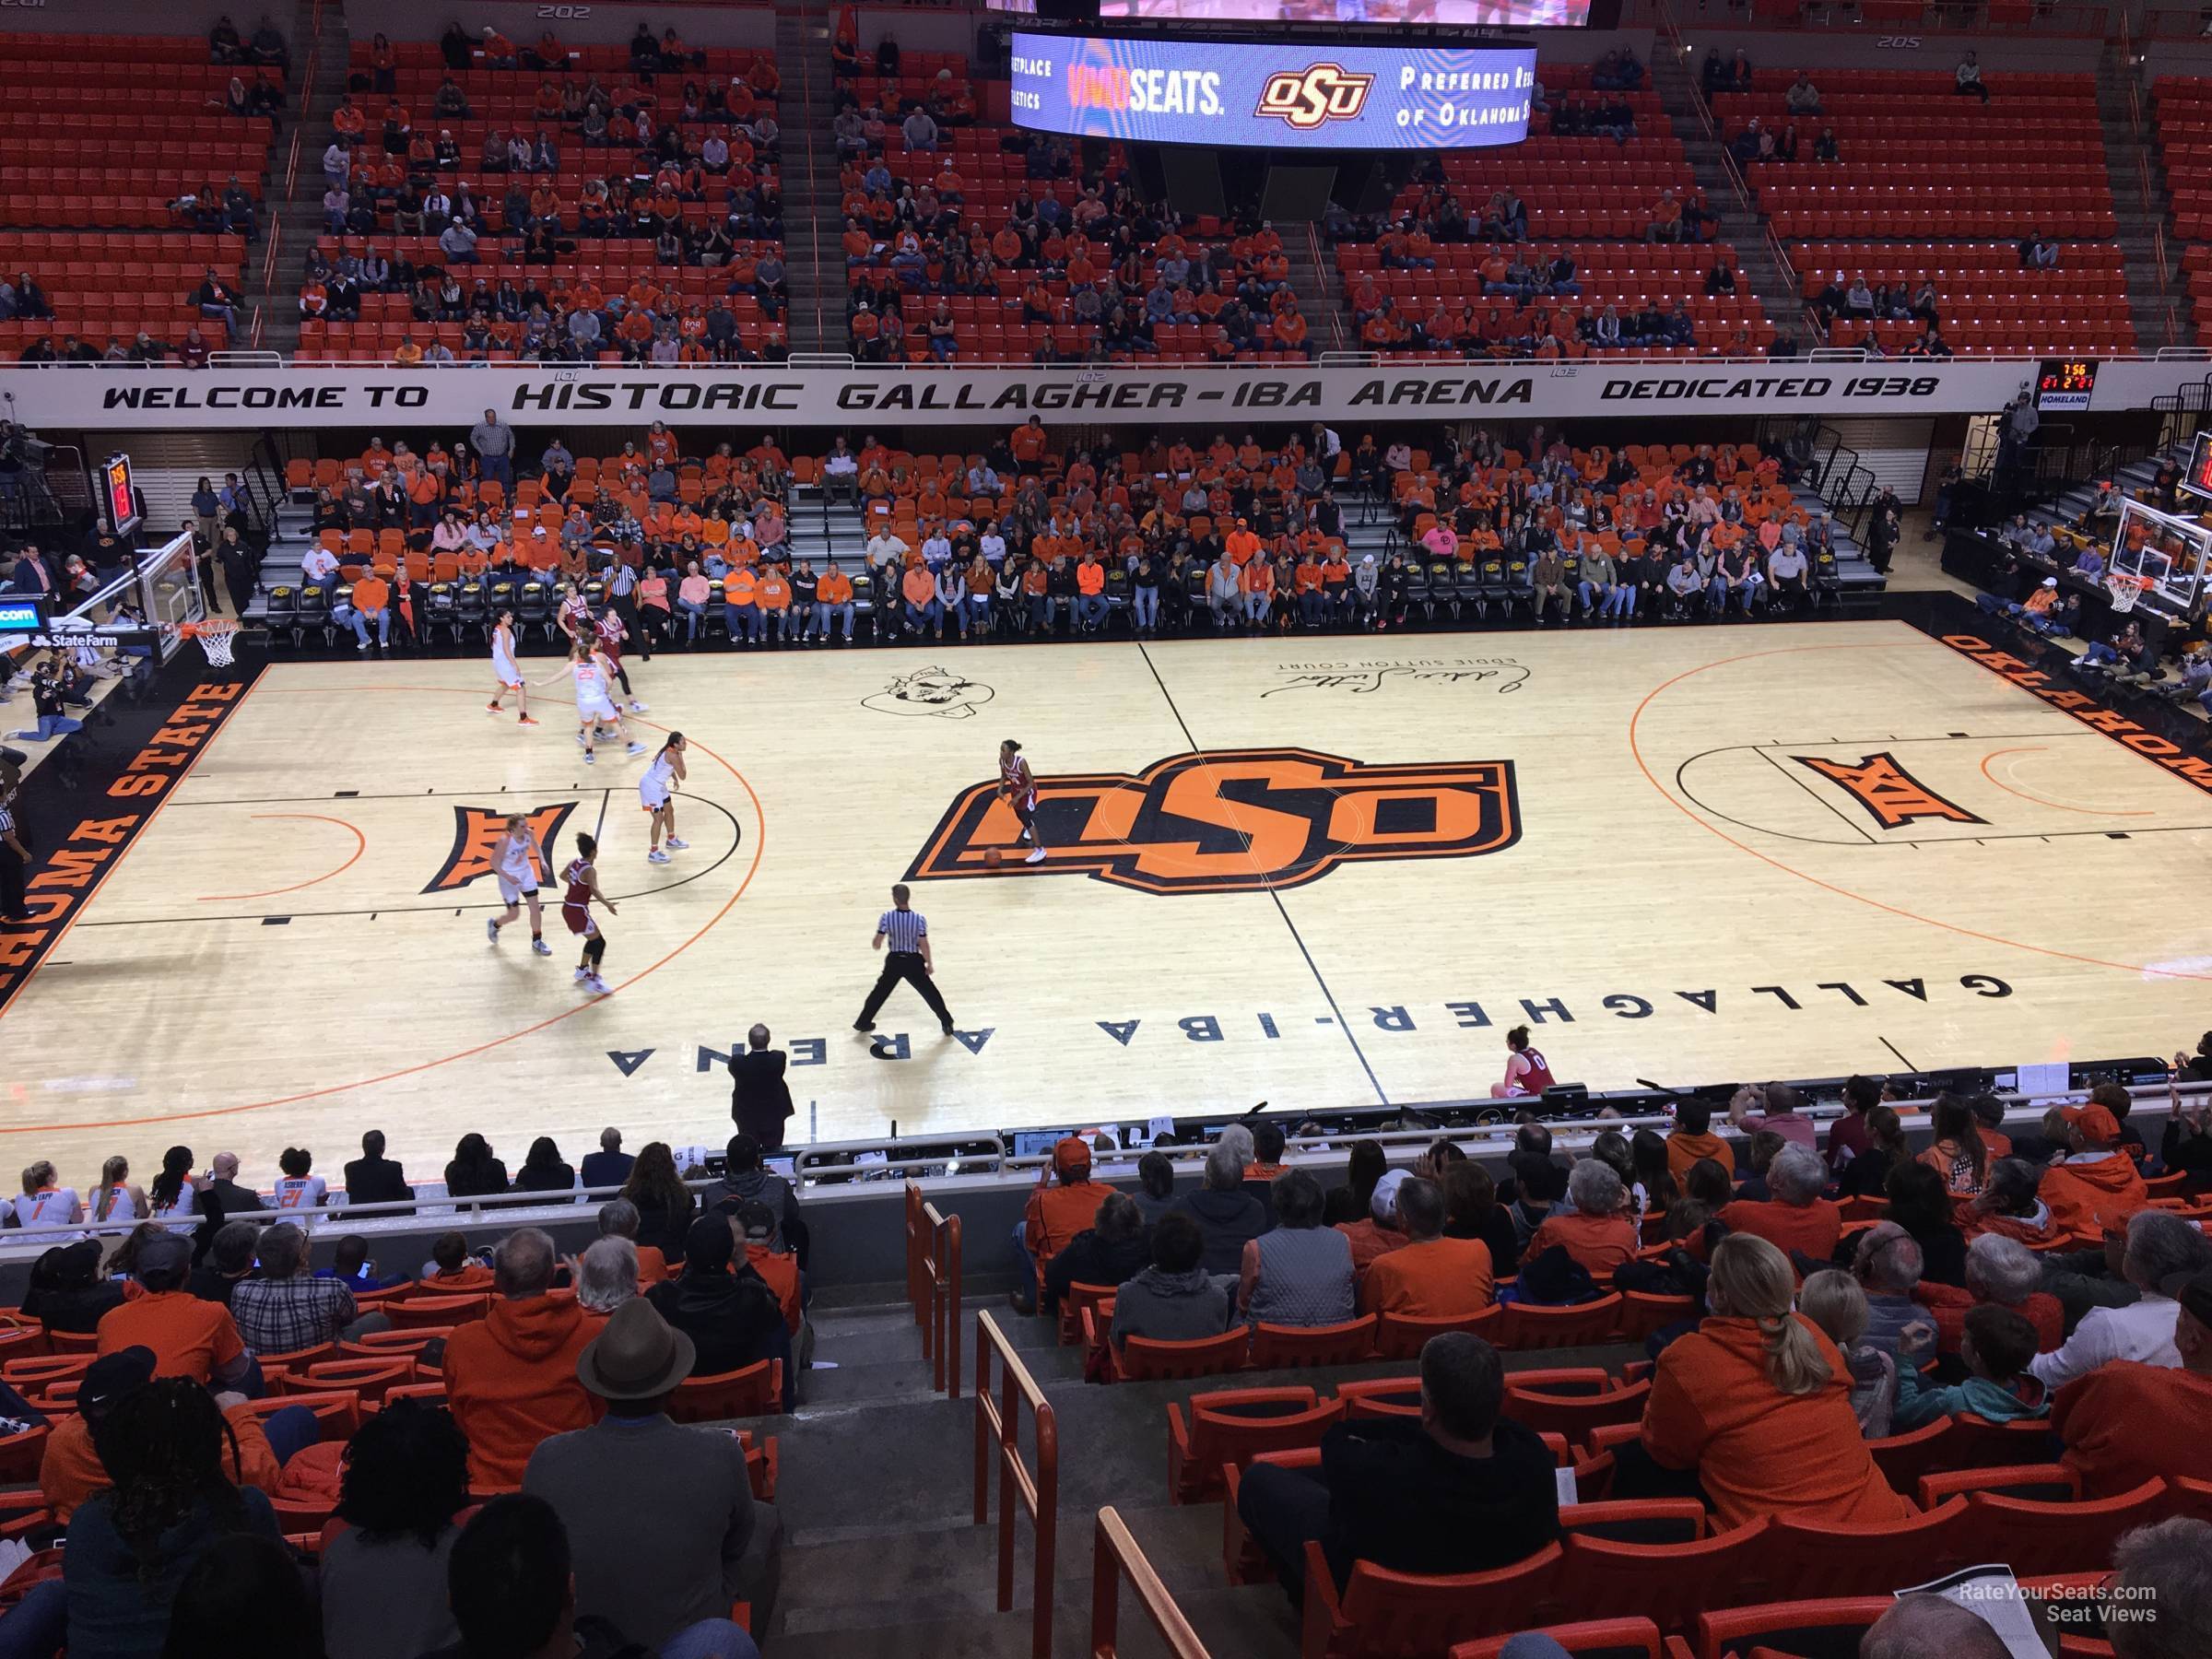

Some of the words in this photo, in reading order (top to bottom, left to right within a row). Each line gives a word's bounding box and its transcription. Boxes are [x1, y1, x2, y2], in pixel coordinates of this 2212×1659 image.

[537, 5, 590, 18] 202
[1877, 36, 1923, 48] 205
[1254, 62, 1376, 130] OSU
[2042, 376, 2058, 389] 21
[2077, 376, 2093, 389] 21
[103, 386, 347, 409] WELCOME
[364, 386, 429, 408] TO
[512, 382, 805, 411] HISTORIC
[837, 380, 1322, 419] GALLAGHER-IBA
[1347, 378, 1534, 406] ARENA
[1600, 378, 1832, 400] DEDICATED
[1841, 377, 1940, 398] 1938
[2041, 395, 2088, 404] HOMELAND
[1277, 662, 1349, 671] COURT
[1359, 660, 1445, 668] SUTTON
[1453, 657, 1519, 665] EDDIE
[106, 682, 244, 797] STATE
[900, 747, 1524, 897] OSU
[1533, 1054, 1547, 1071] 0
[280, 1189, 302, 1208] 21
